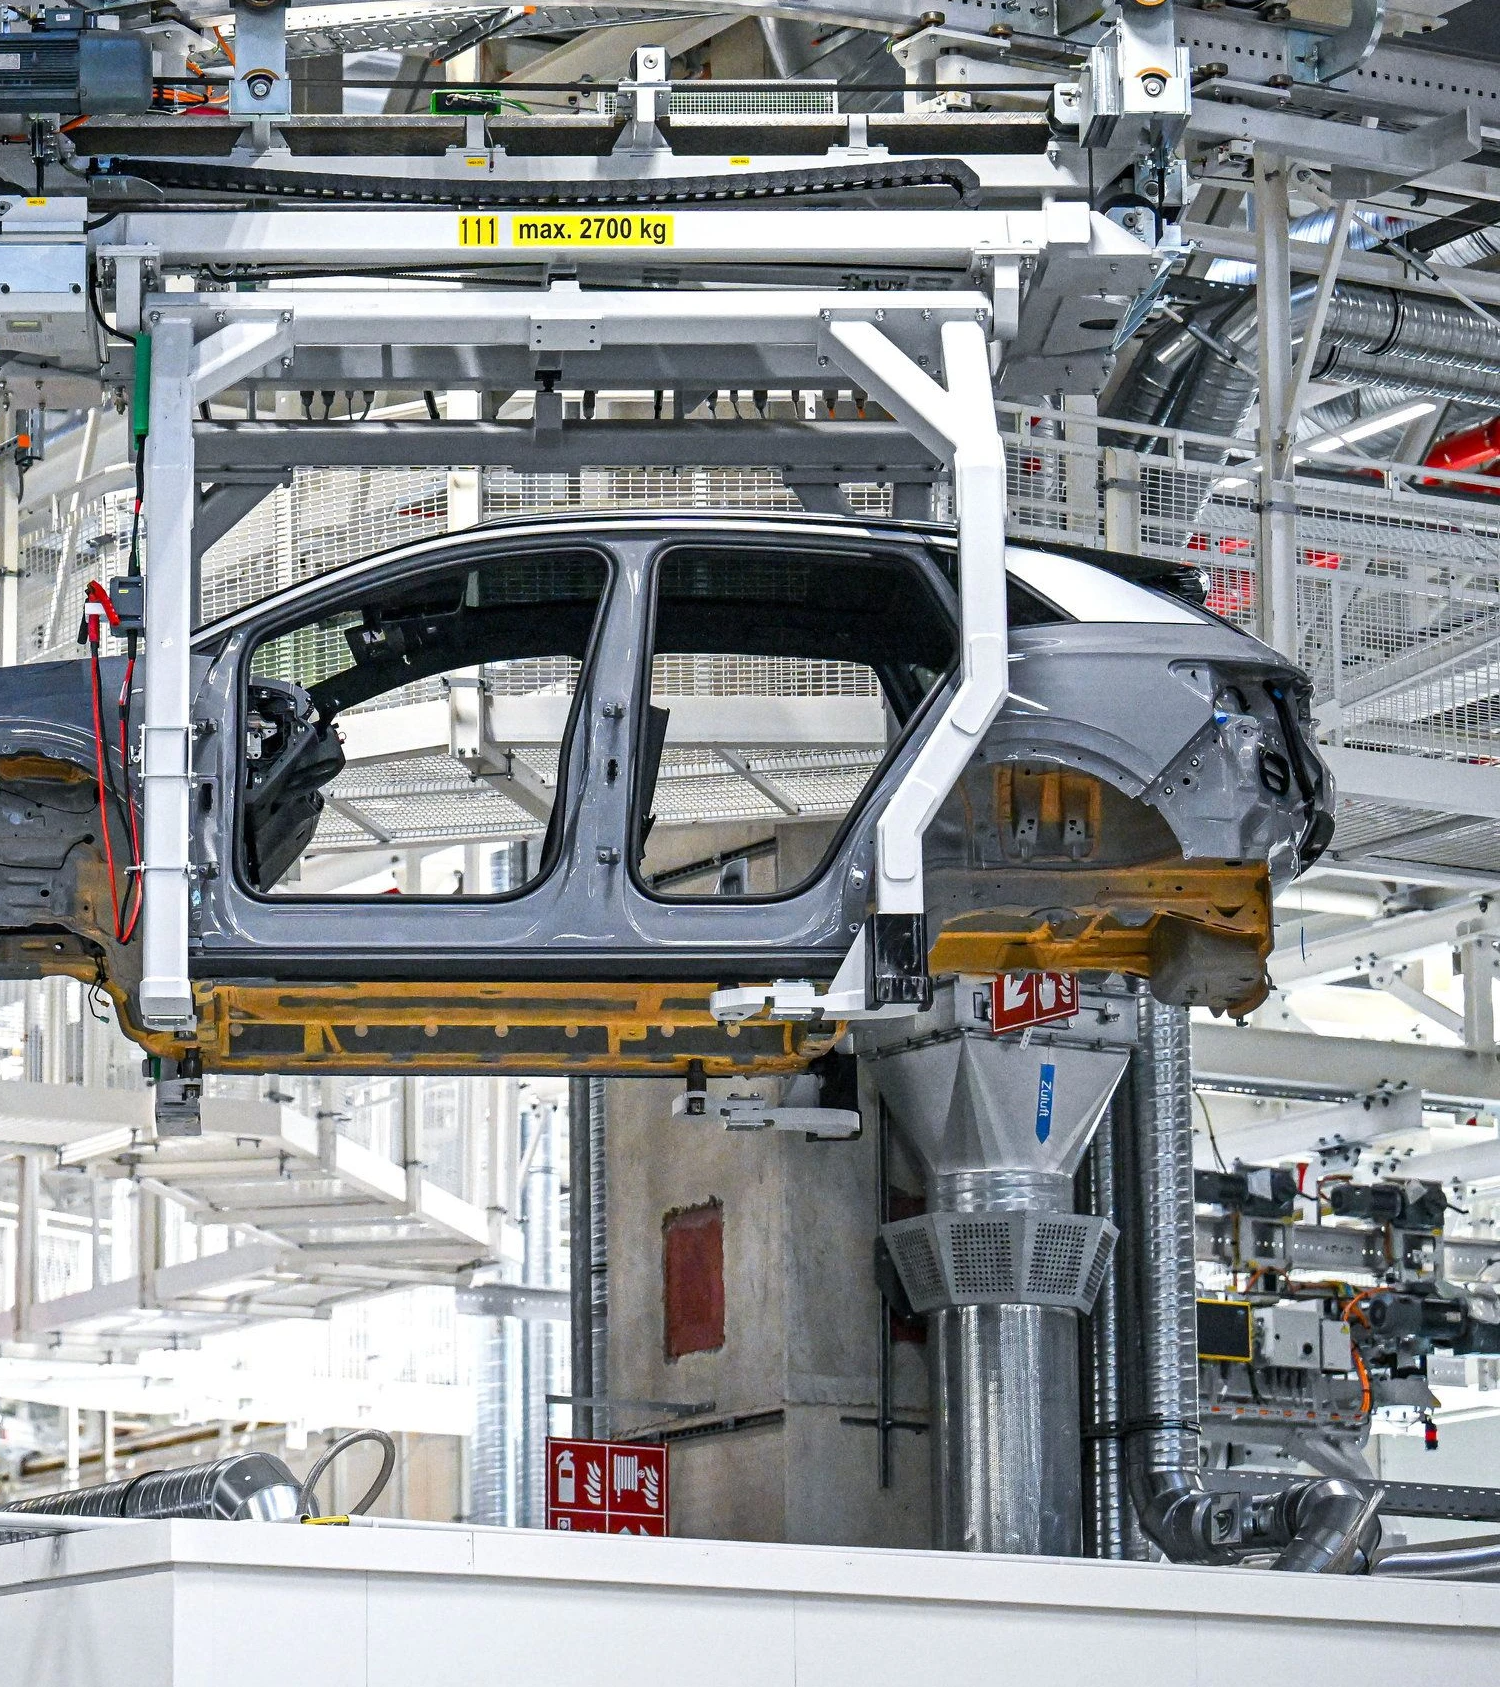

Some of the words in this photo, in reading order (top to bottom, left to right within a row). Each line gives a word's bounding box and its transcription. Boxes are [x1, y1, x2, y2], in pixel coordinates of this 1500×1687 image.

[462, 218, 495, 244] 111
[519, 222, 572, 239] max.
[579, 218, 632, 239] 2700
[640, 218, 666, 245] kg
[1038, 1080, 1052, 1117] Zuluft
